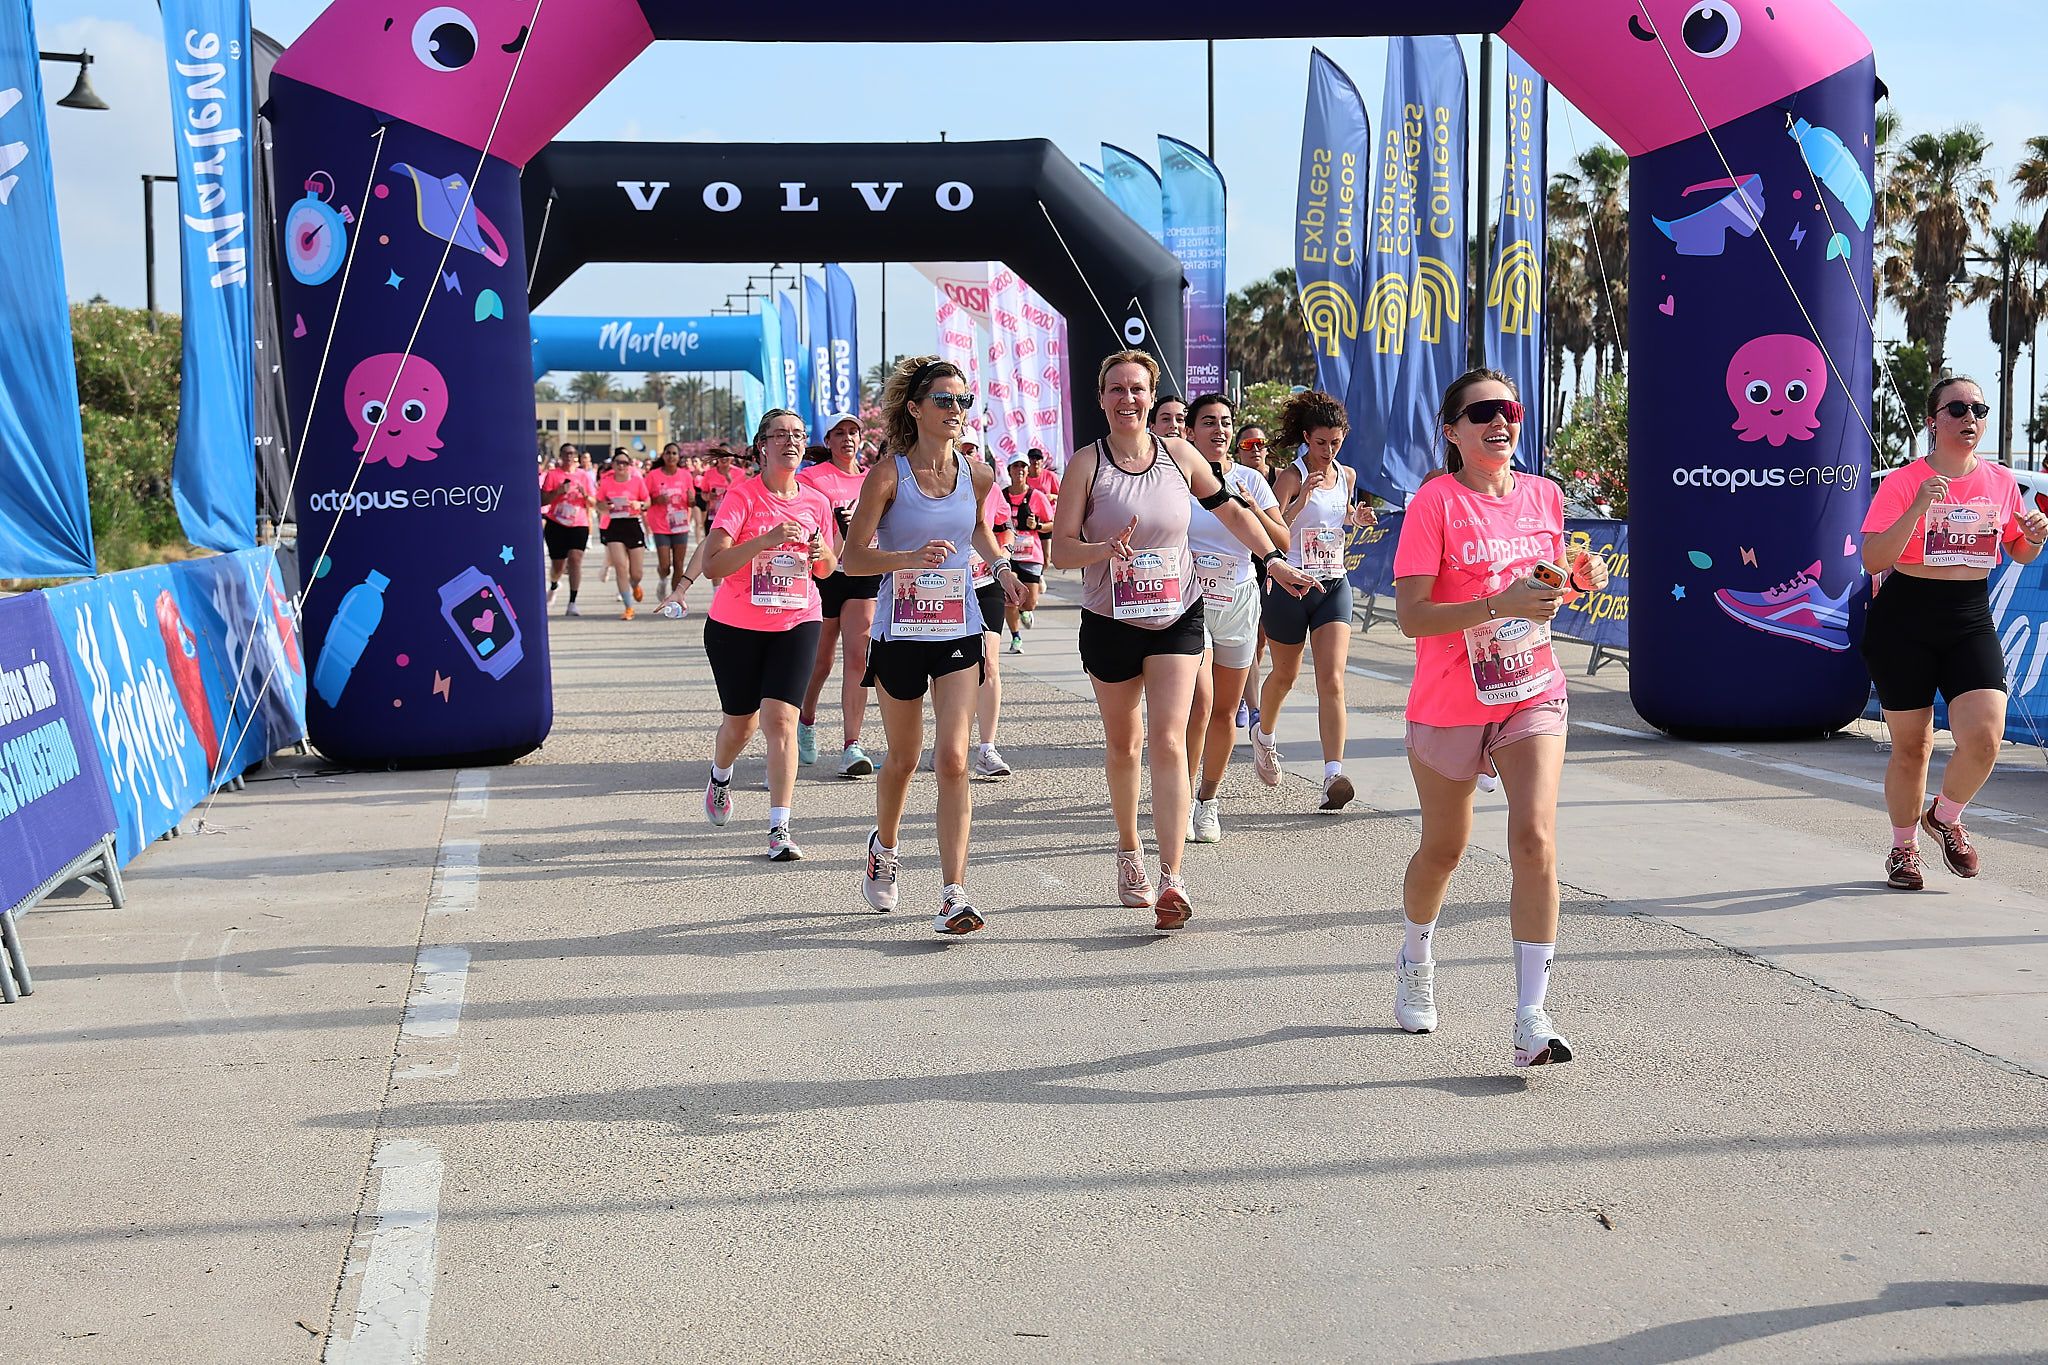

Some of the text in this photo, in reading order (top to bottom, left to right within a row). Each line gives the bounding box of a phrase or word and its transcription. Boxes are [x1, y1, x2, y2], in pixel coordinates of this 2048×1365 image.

[617, 181, 974, 212] VOLVO
[598, 320, 699, 365] Marlene
[1672, 463, 1862, 493] octopus energy
[310, 484, 504, 517] octopus energy
[1453, 516, 1491, 529] OYSHO
[1949, 533, 1977, 545] 016
[1462, 535, 1545, 565] CARRERA
[772, 576, 794, 586] 016
[1136, 579, 1164, 592] 016
[916, 600, 944, 611] 016
[1122, 607, 1145, 615] OYSHO
[1473, 629, 1493, 638] SUMA
[1503, 650, 1535, 672] 016
[1487, 690, 1519, 700] OYSHO
